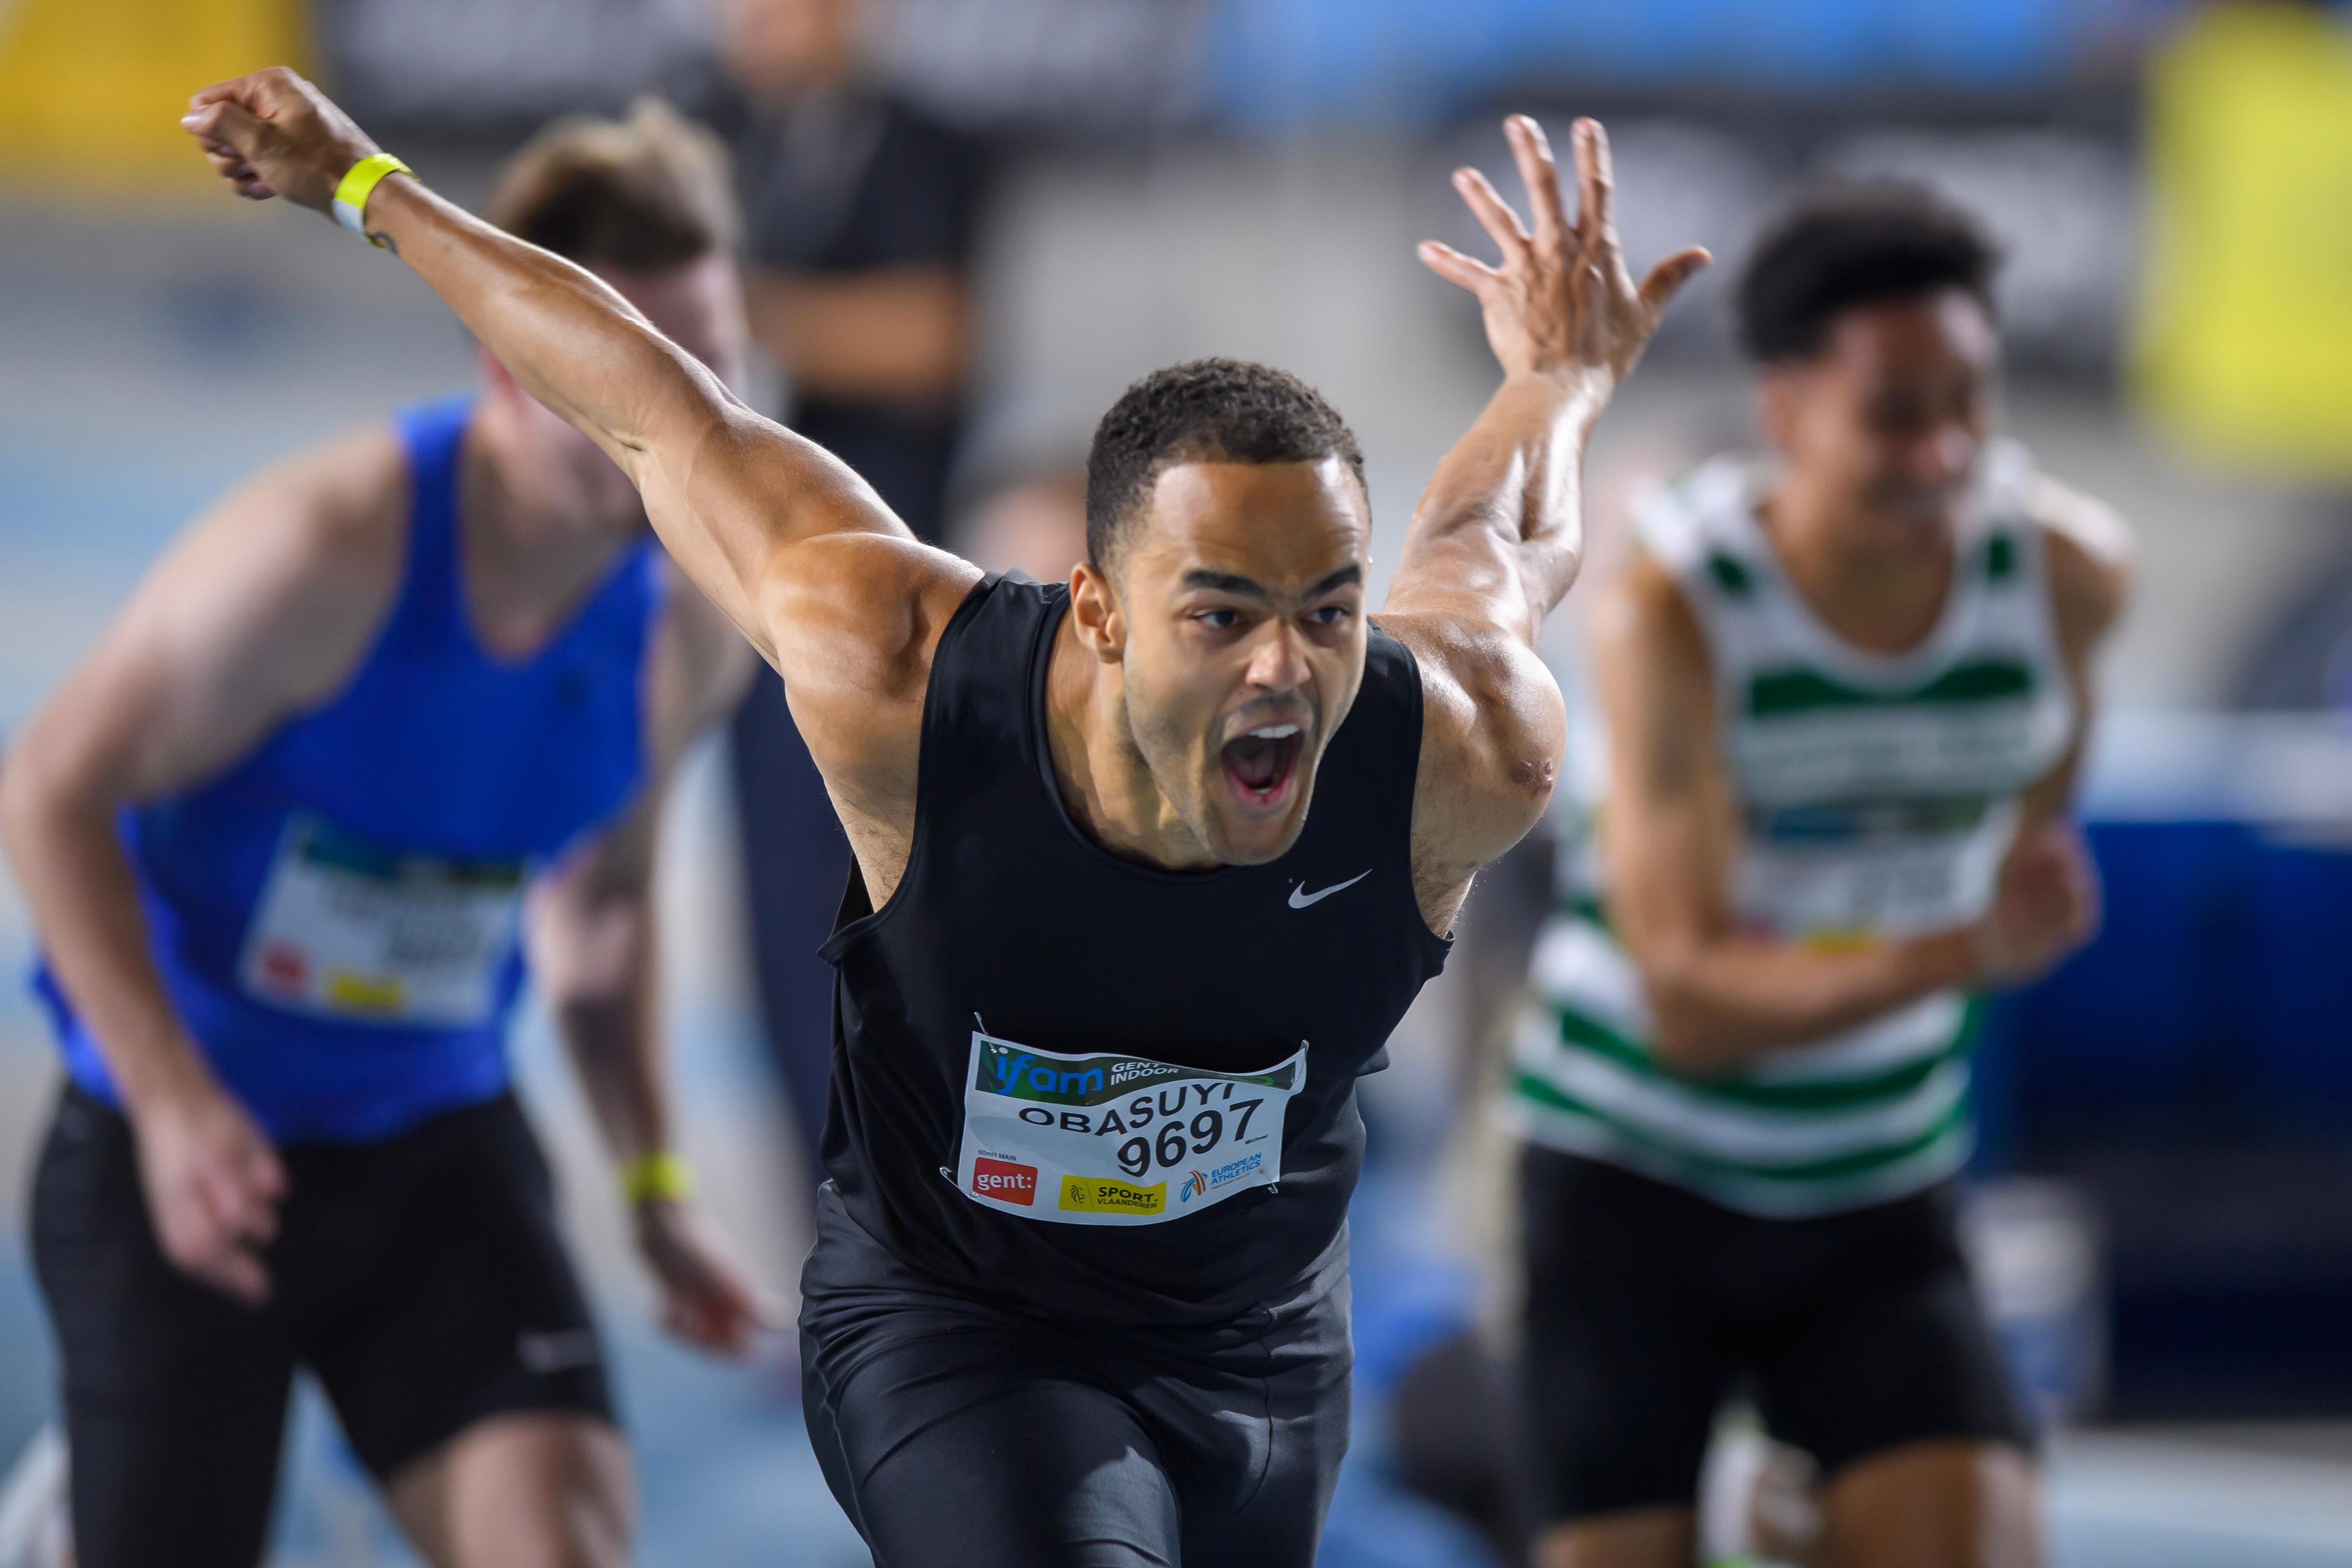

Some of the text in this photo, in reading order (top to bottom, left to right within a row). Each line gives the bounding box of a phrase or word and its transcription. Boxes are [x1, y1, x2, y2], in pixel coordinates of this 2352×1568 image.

[997, 1047, 1103, 1095] ifam
[1110, 1068, 1179, 1085] INDOOR
[1111, 1062, 1163, 1072] GENT
[1019, 1082, 1235, 1136] OBASUYI
[1117, 1098, 1264, 1177] 9697
[1211, 1159, 1261, 1185] ATHLETICS
[1212, 1152, 1262, 1177] EUROPEAN
[977, 1174, 1032, 1191] gent:
[1097, 1198, 1157, 1208] VLAANDEREN
